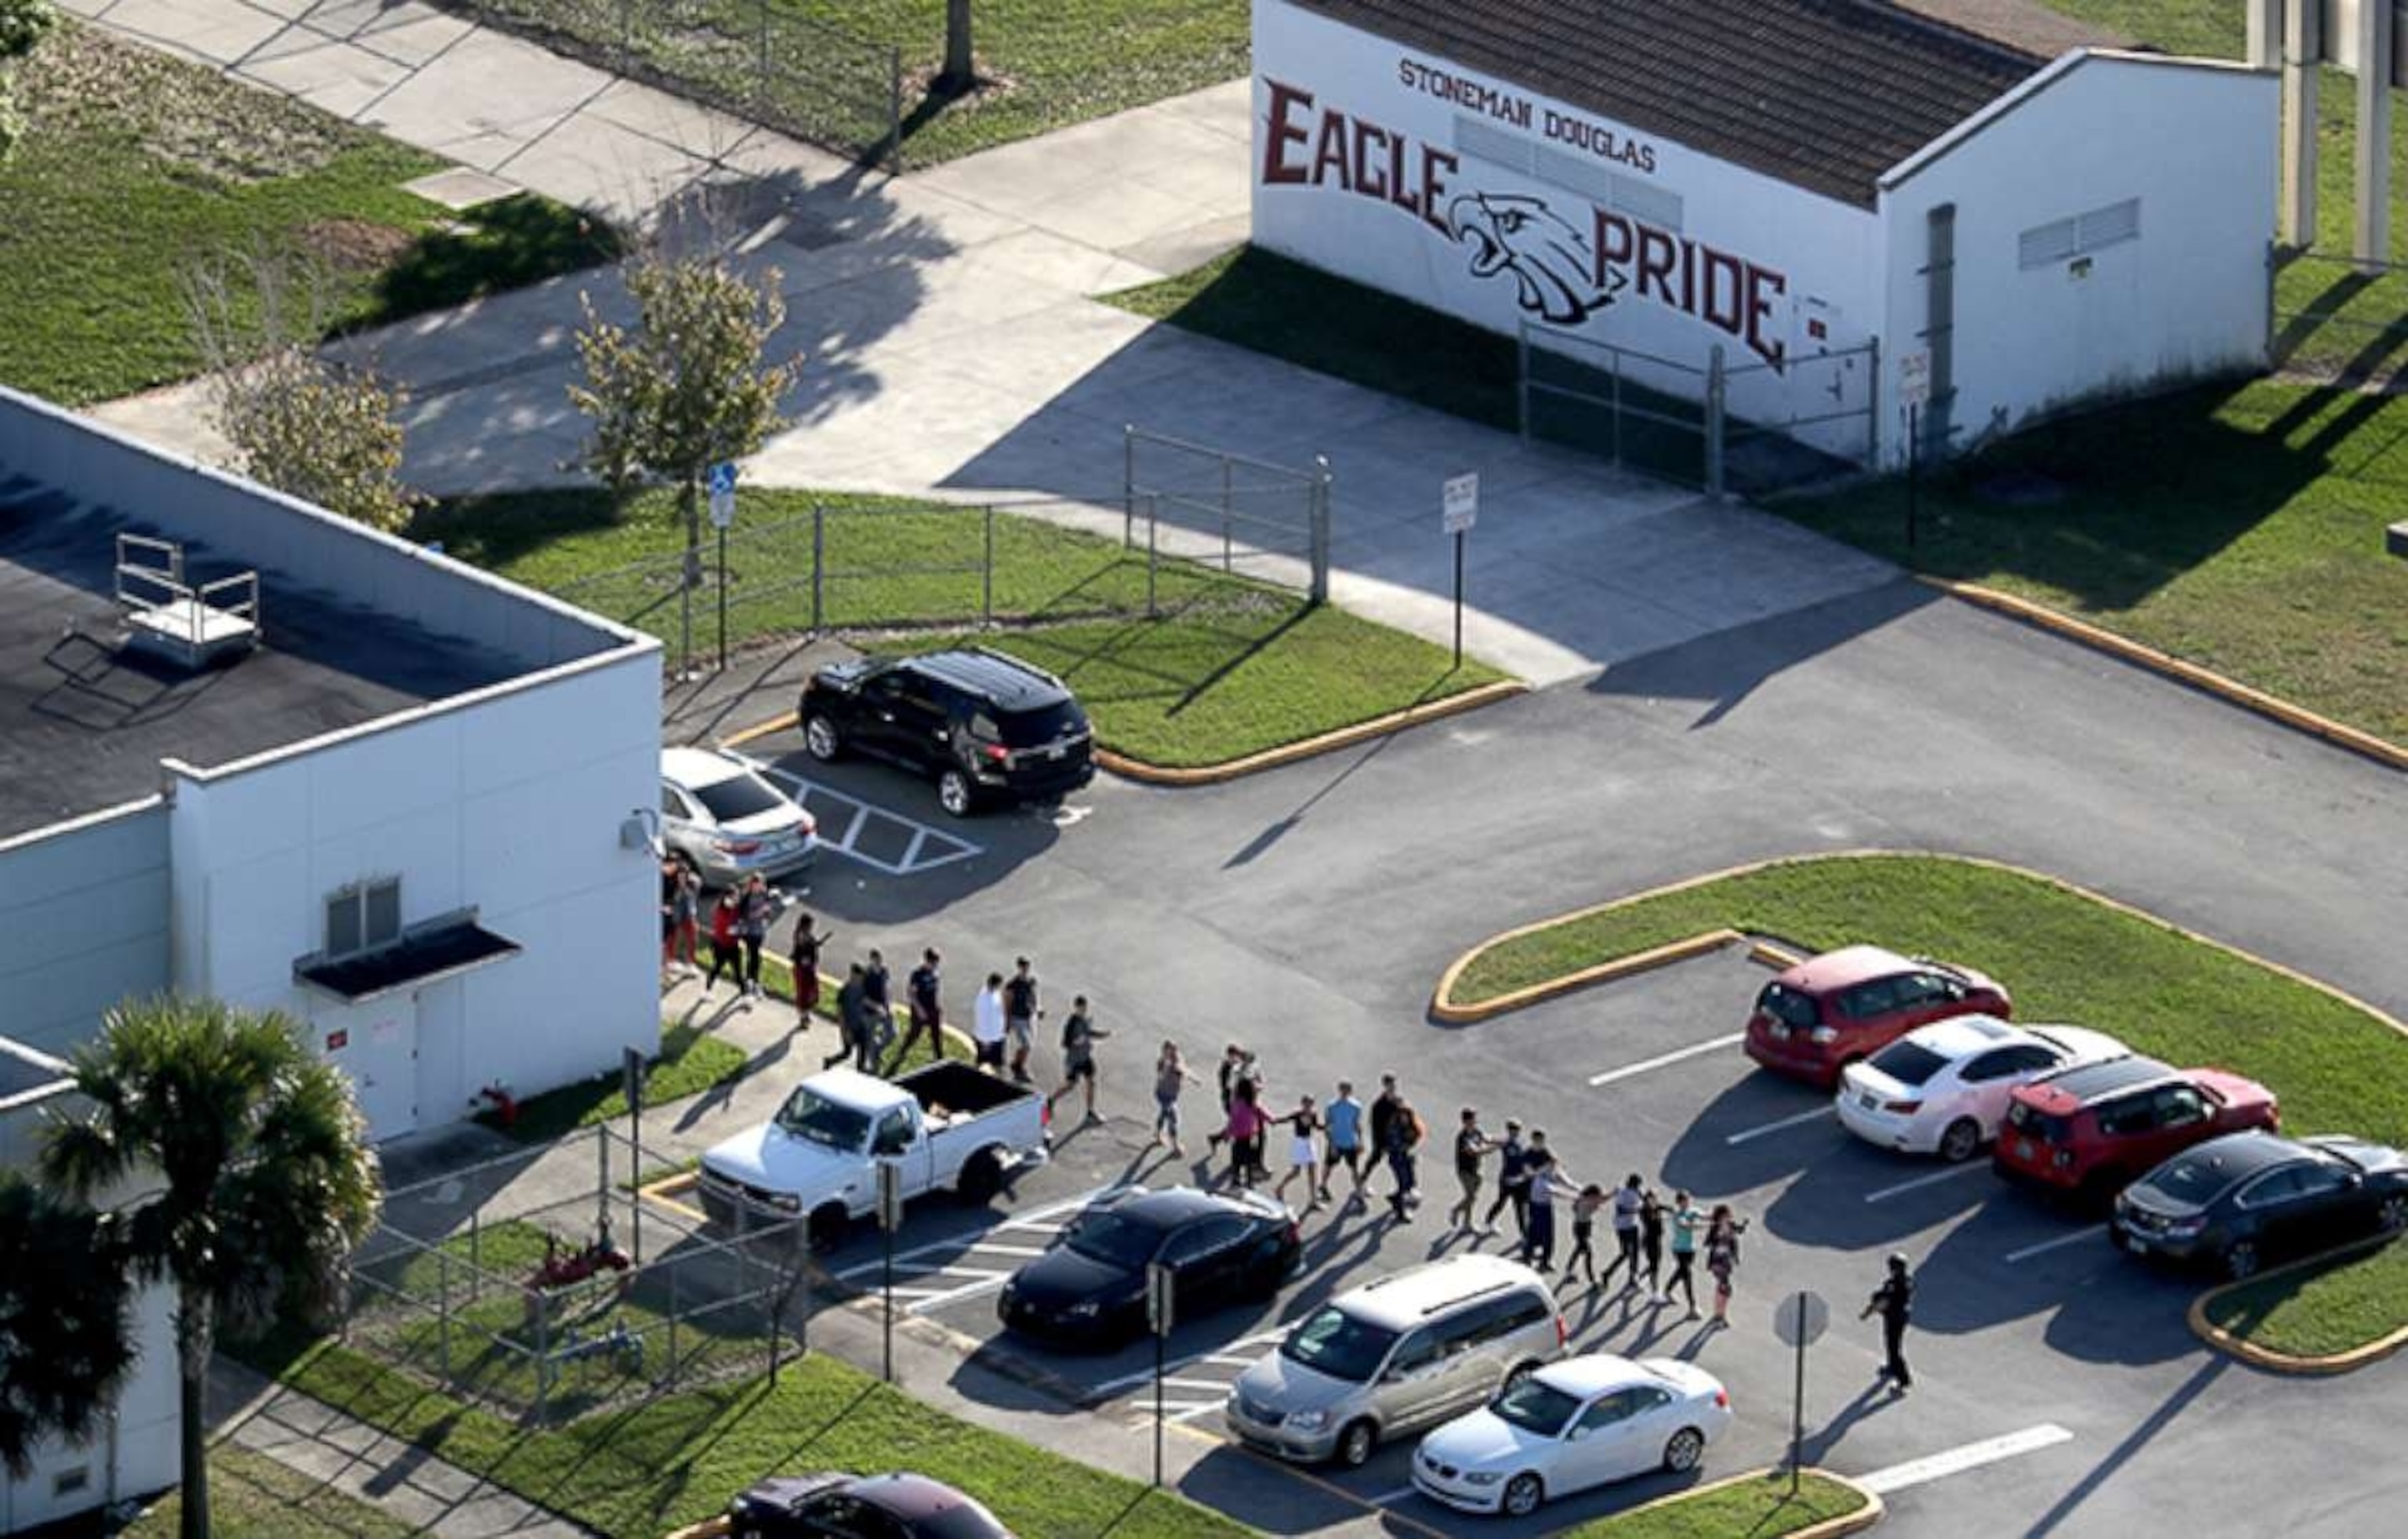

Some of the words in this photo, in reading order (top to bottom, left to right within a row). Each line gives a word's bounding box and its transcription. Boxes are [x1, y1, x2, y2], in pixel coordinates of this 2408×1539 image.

[1398, 57, 1532, 129] STONEMAN
[1543, 109, 1656, 173] DOUGLAS
[1261, 74, 1459, 241] EAGLE
[1591, 204, 1786, 377] PRIDE
